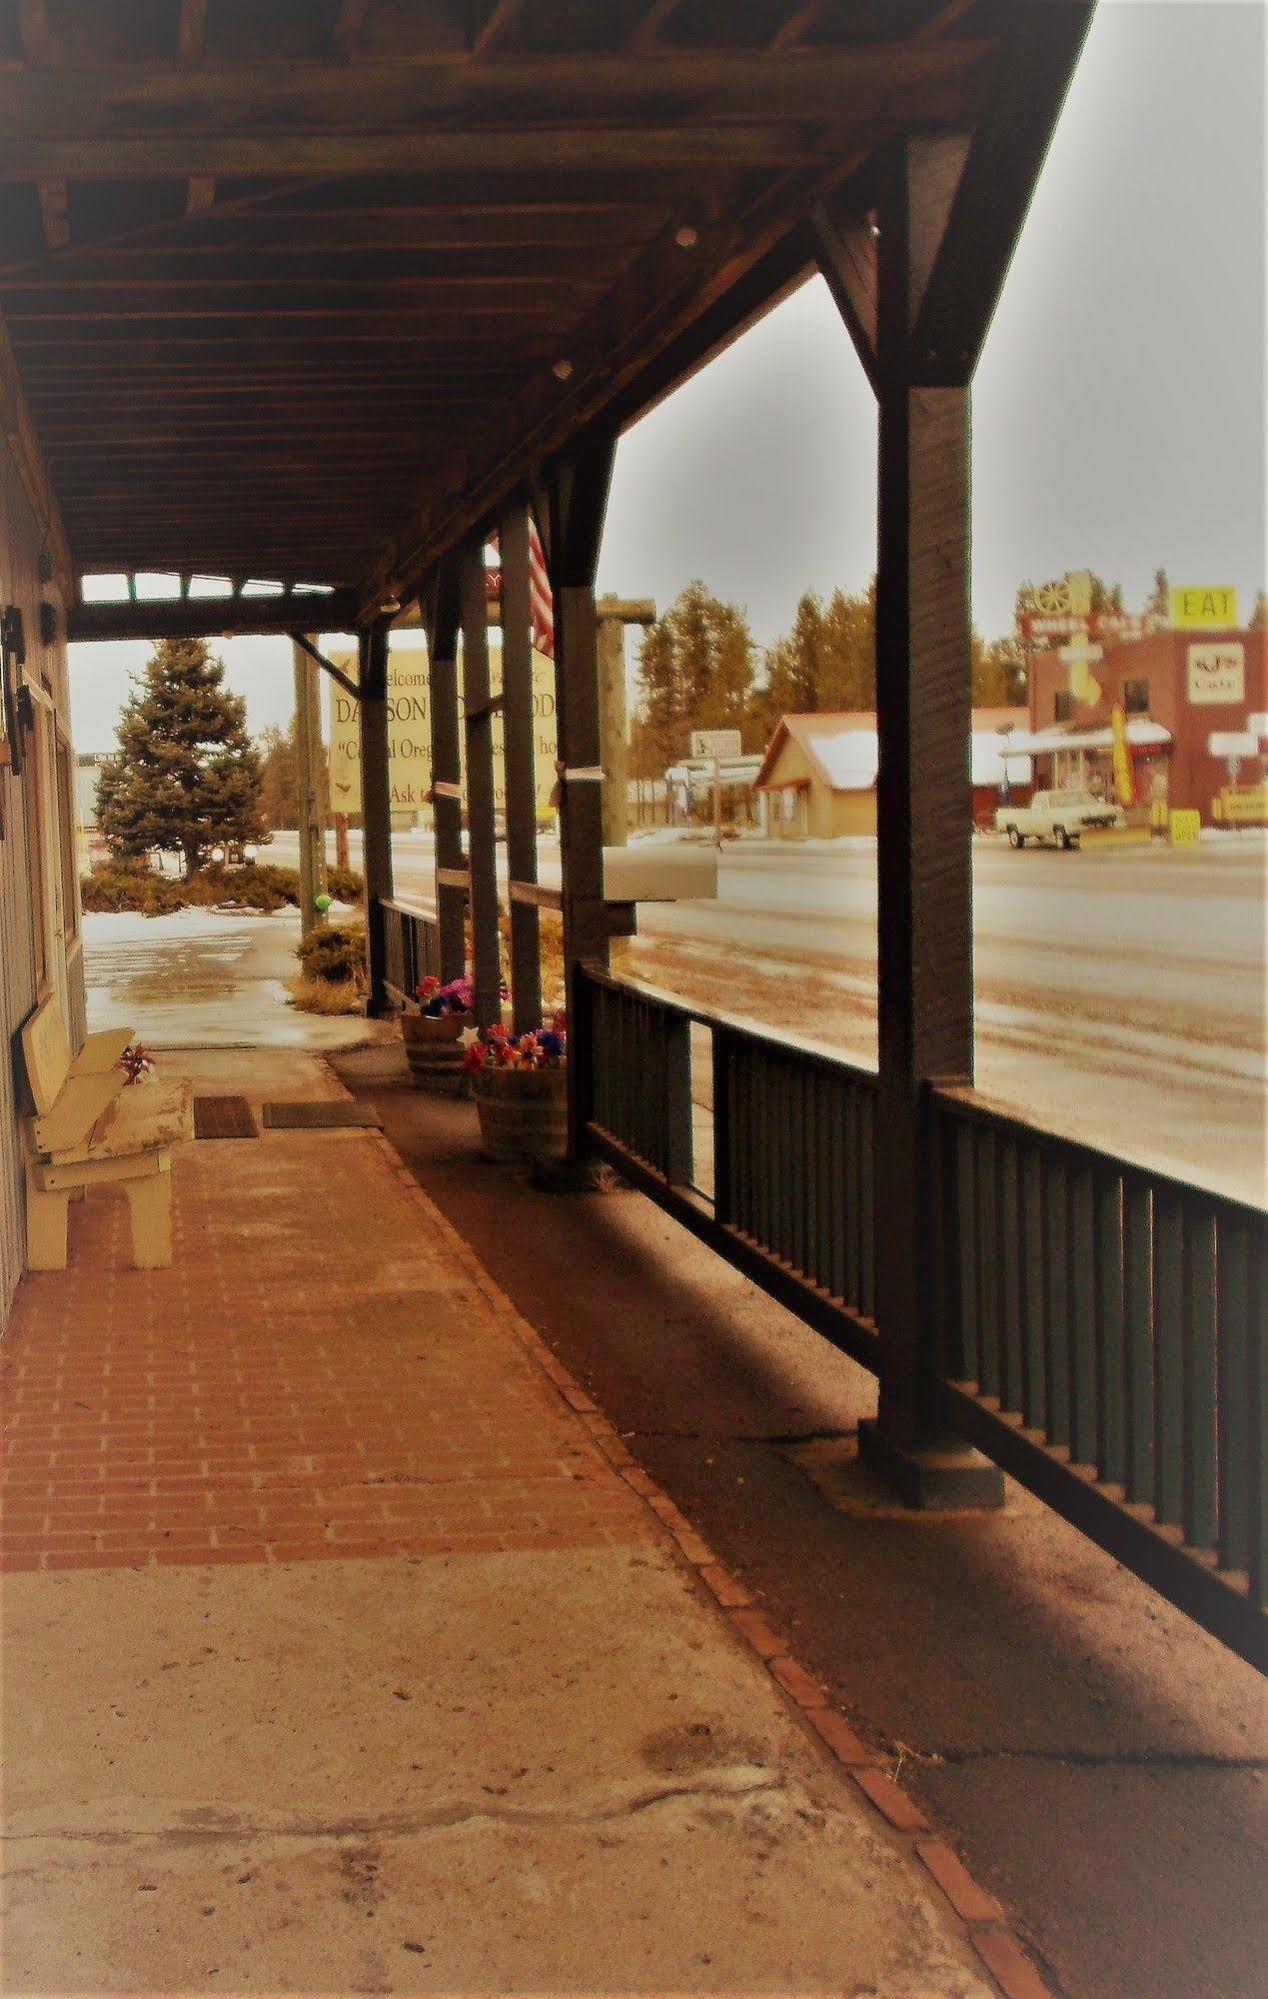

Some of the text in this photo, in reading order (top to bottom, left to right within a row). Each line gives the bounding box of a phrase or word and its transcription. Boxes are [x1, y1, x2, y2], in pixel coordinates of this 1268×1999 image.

[1183, 592, 1232, 616] EAT
[387, 669, 430, 687] elcome
[336, 698, 427, 722] DASON
